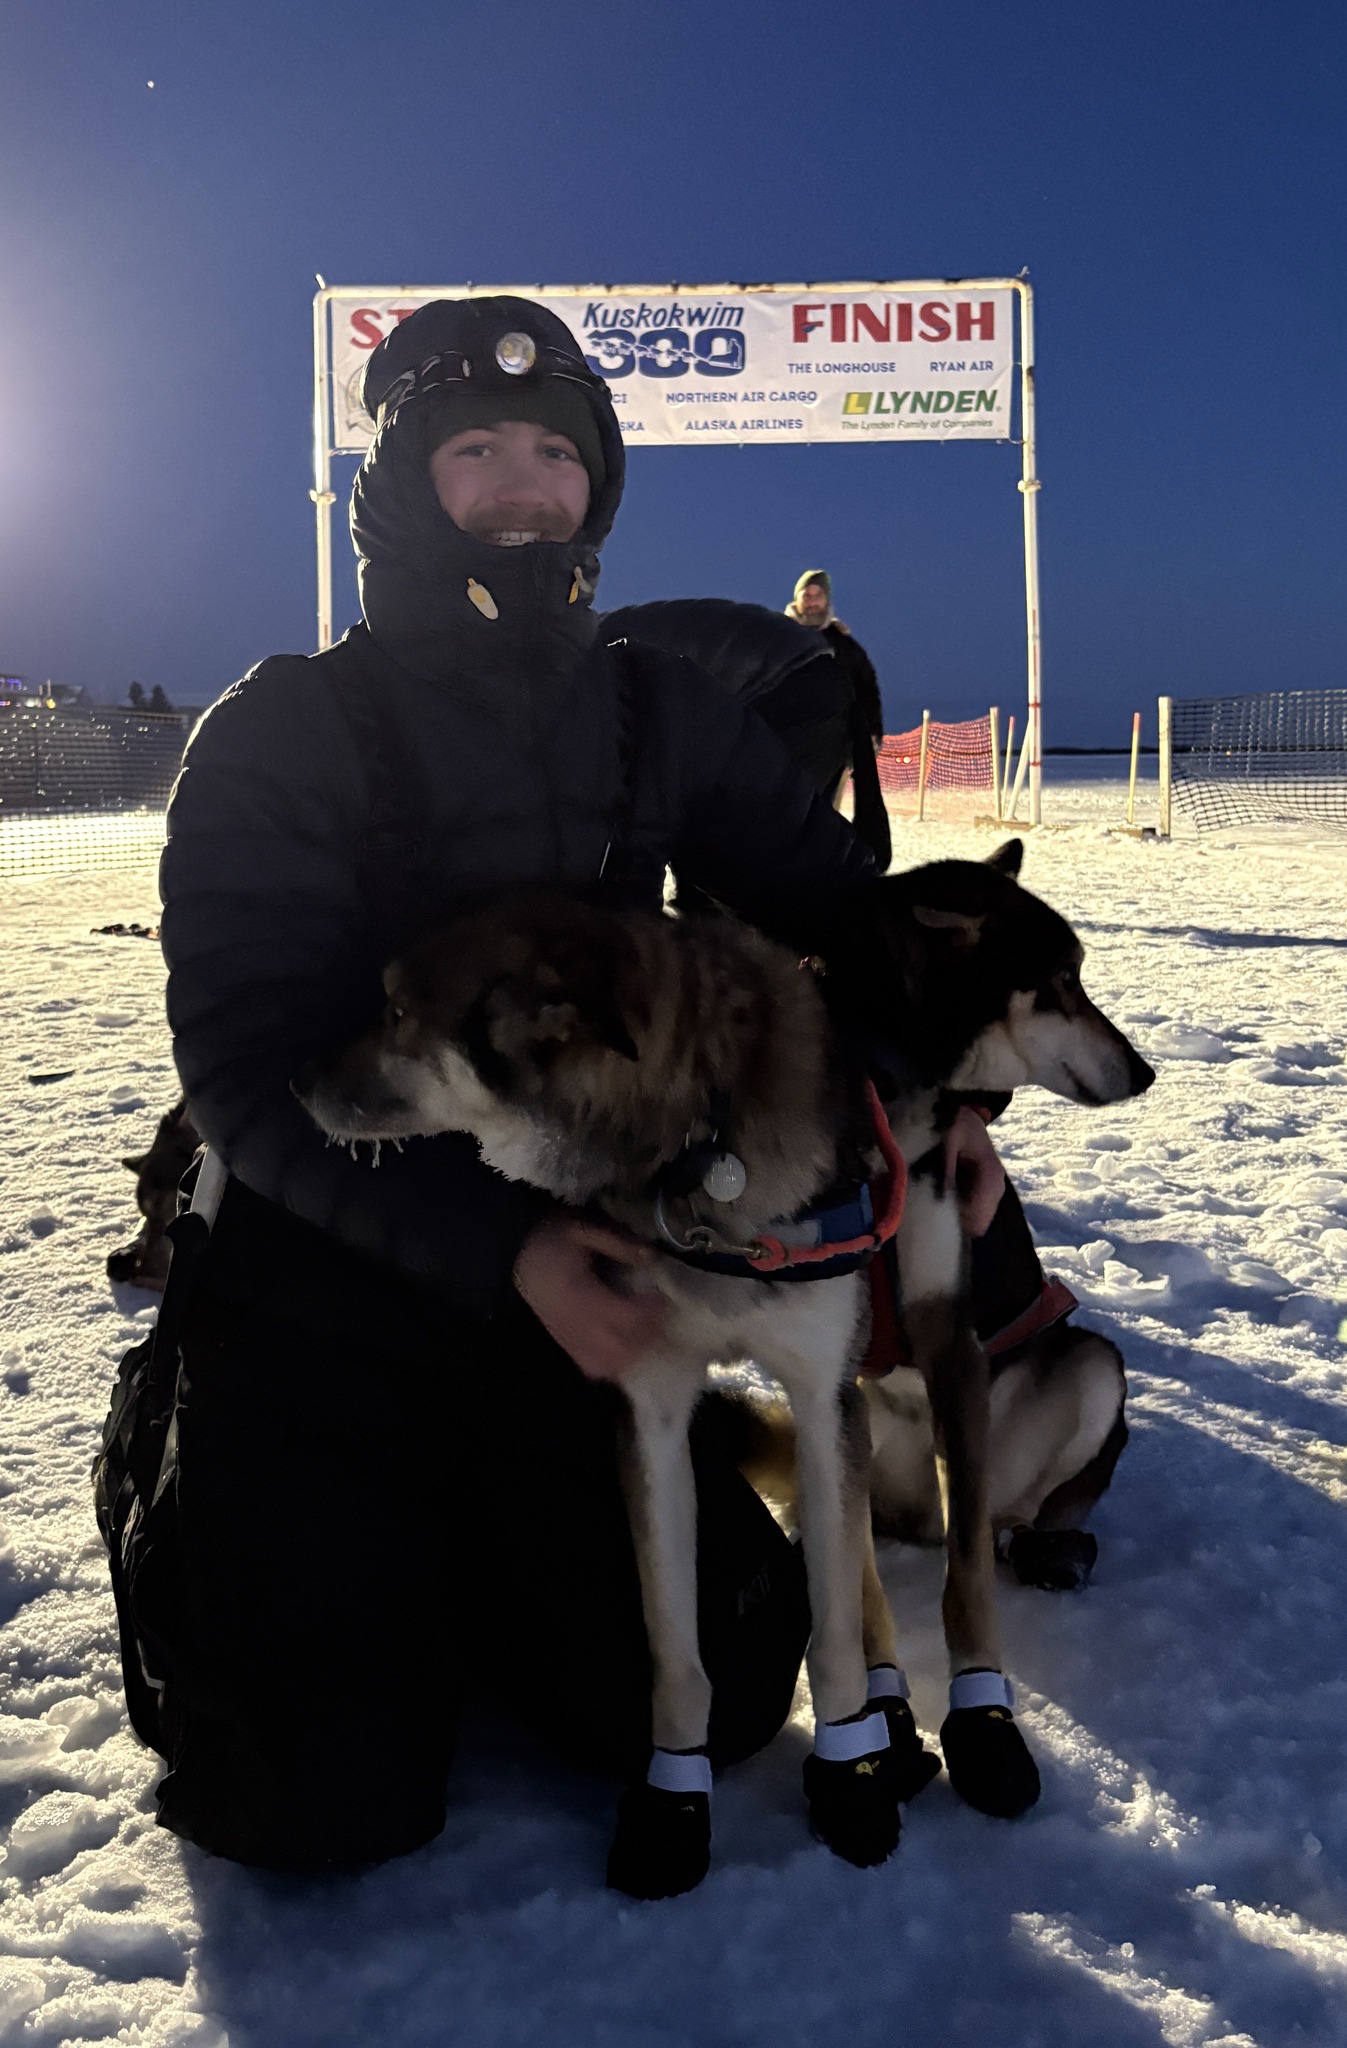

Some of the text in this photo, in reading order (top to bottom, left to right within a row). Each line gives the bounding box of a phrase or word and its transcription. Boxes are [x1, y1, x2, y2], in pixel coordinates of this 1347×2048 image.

[583, 302, 744, 328] Kuskokwim
[792, 301, 995, 343] FINISH
[585, 327, 746, 379] 300
[788, 362, 896, 374] THE LONGHOUSE
[930, 360, 994, 372] RYAN AIR
[666, 391, 817, 404] NORTHERN AIR CARGO
[873, 389, 997, 414] LYNDEN
[685, 418, 803, 431] ALASKA AIRLINES
[842, 418, 994, 431] The Lynden Family of Companies
